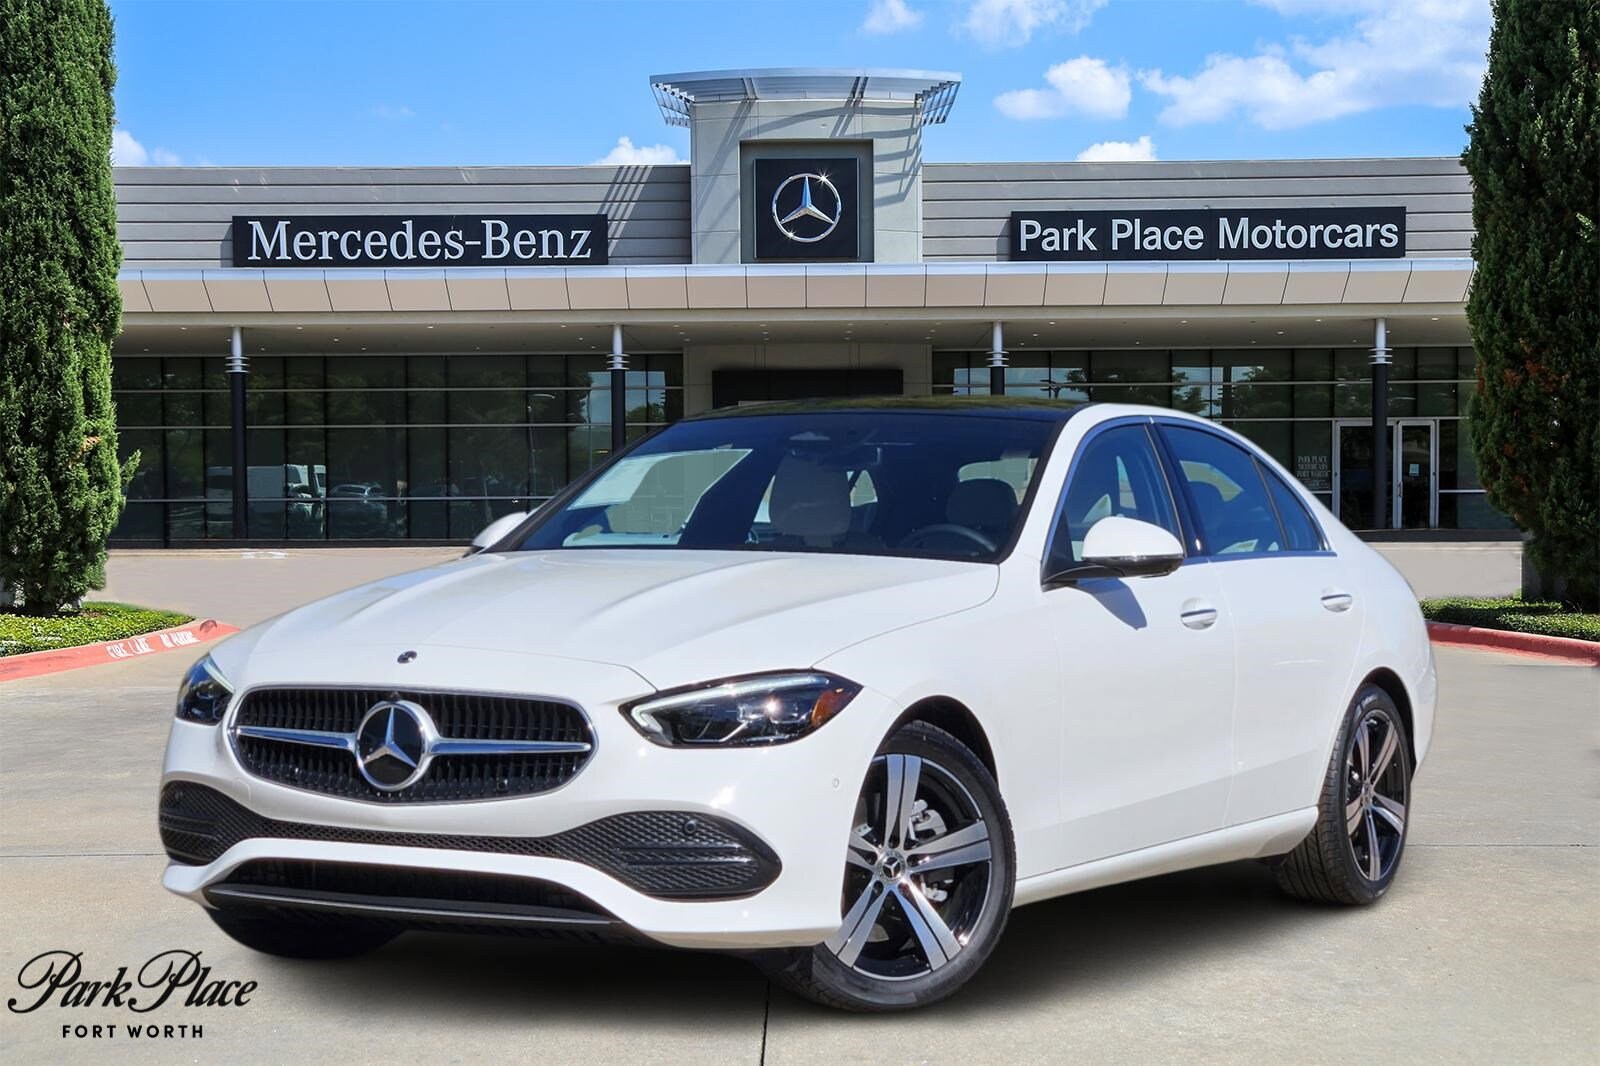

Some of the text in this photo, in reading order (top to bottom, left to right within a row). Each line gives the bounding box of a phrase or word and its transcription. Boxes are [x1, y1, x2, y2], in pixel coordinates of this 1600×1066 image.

[247, 219, 592, 261] Mercedes-Benz
[1019, 216, 1399, 252] Park Place Motorcars
